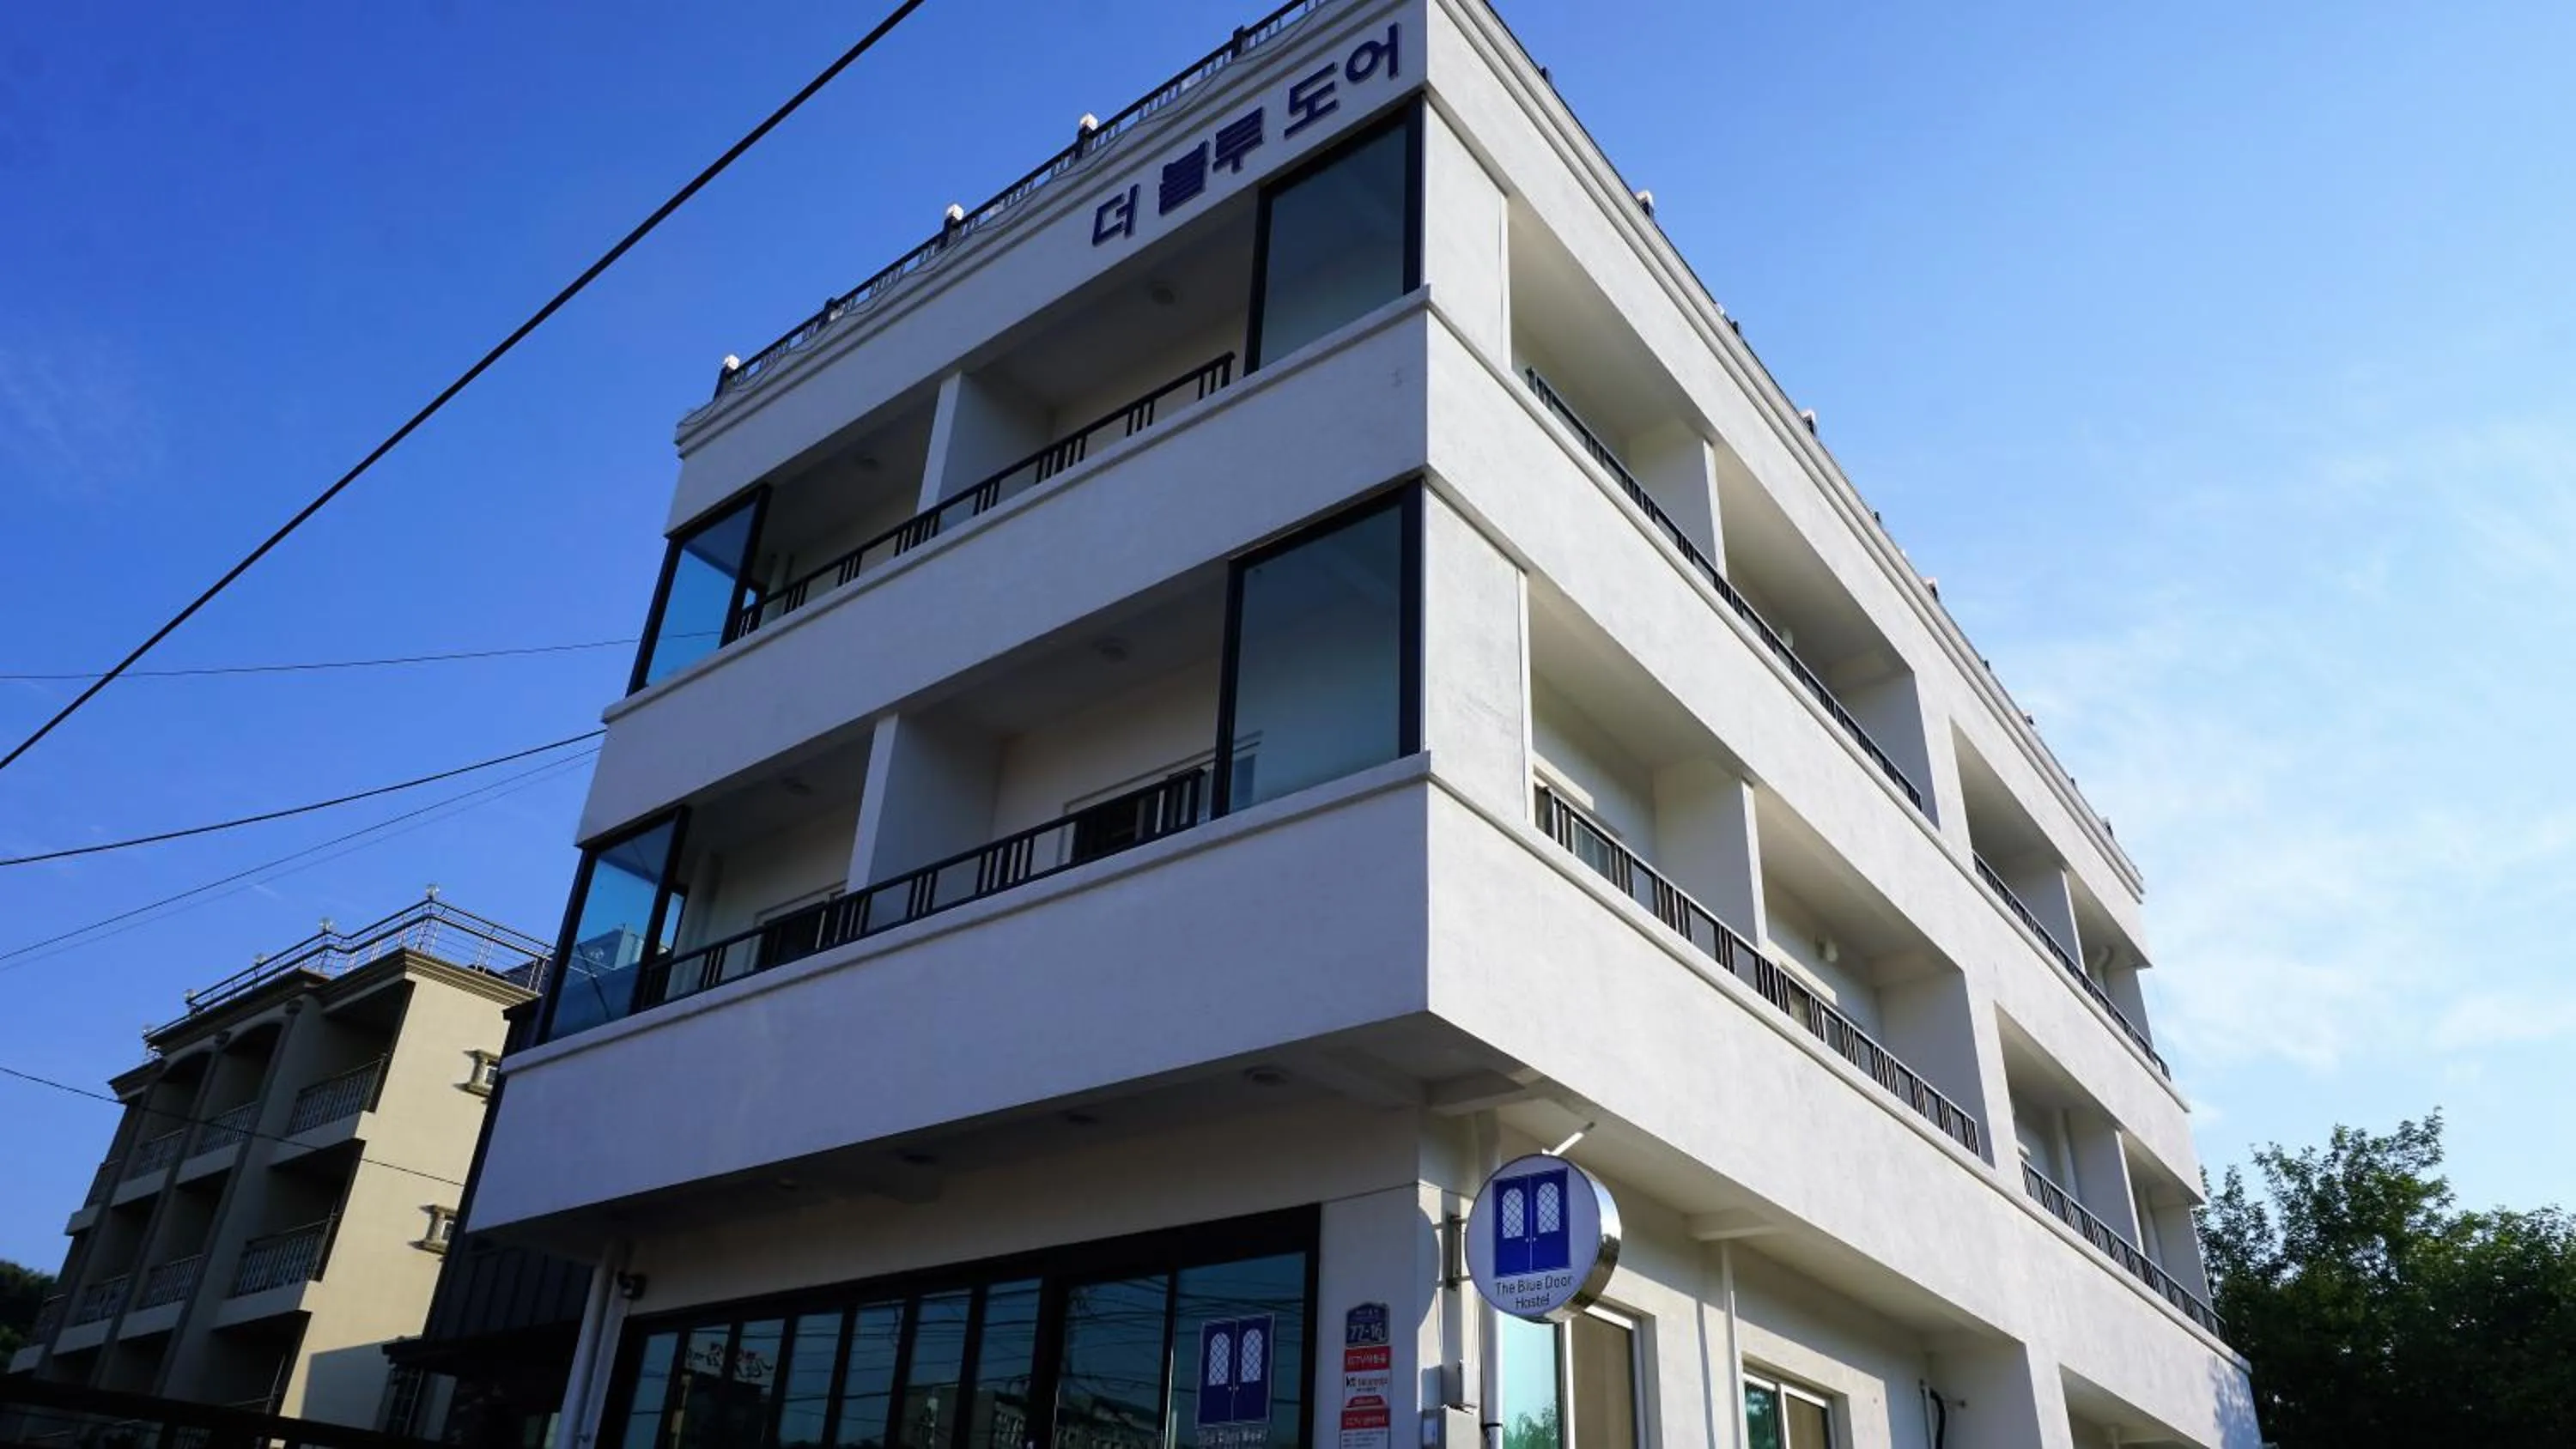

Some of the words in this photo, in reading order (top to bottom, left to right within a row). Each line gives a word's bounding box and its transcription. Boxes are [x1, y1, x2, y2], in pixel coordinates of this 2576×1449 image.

[1092, 183, 1140, 246] 더
[1284, 21, 1401, 139] 도어
[1497, 1282, 1516, 1296] The
[1517, 1279, 1542, 1293] Blue
[1545, 1275, 1573, 1289] Door
[1516, 1294, 1550, 1309] Hostel
